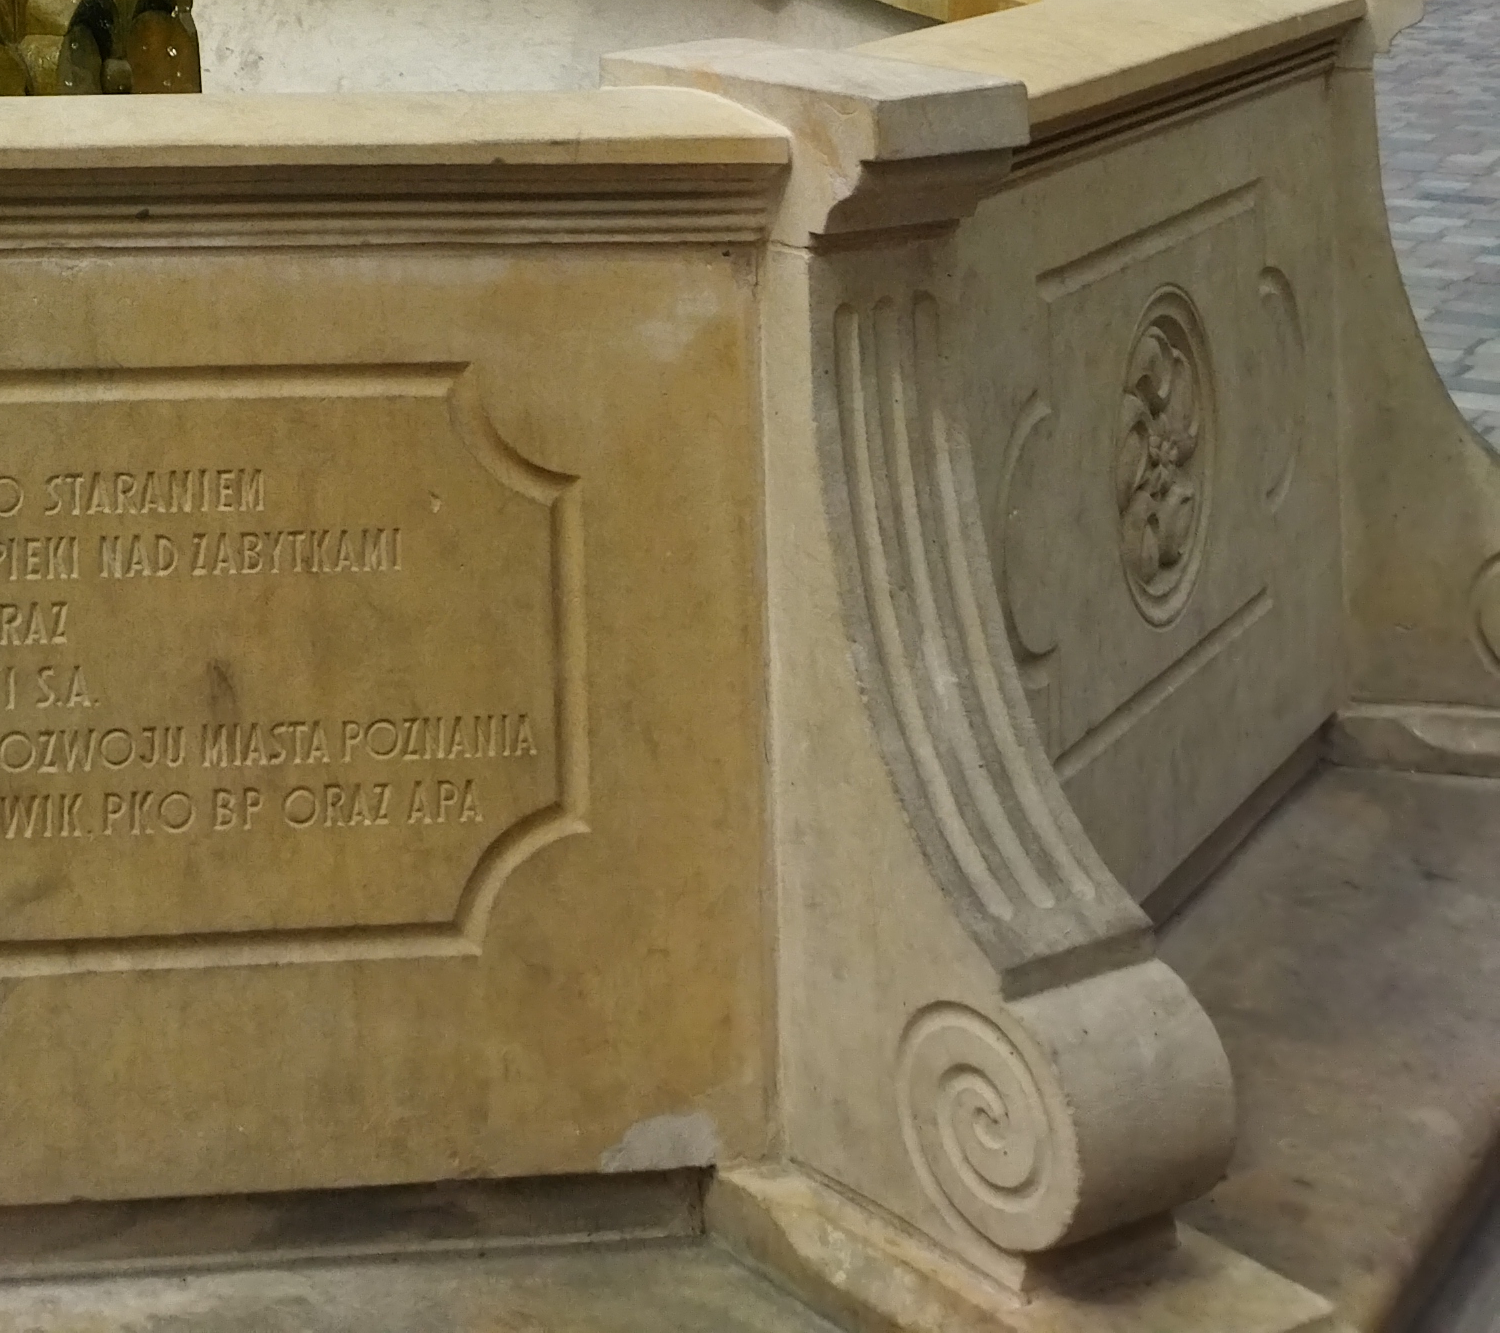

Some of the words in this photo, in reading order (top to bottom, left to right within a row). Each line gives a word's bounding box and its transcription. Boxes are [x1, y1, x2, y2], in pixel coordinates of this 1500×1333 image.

[43, 468, 265, 516] STARANIEM
[100, 532, 178, 578] NAD
[192, 527, 402, 576] ZABYTKAMI
[35, 664, 100, 708] S.A.
[202, 720, 331, 768] MIASTA
[341, 713, 537, 763] POZNANIA
[102, 790, 196, 835] PKO
[213, 787, 264, 831] BP
[283, 783, 392, 829] ORAZ
[407, 779, 484, 825] APA
